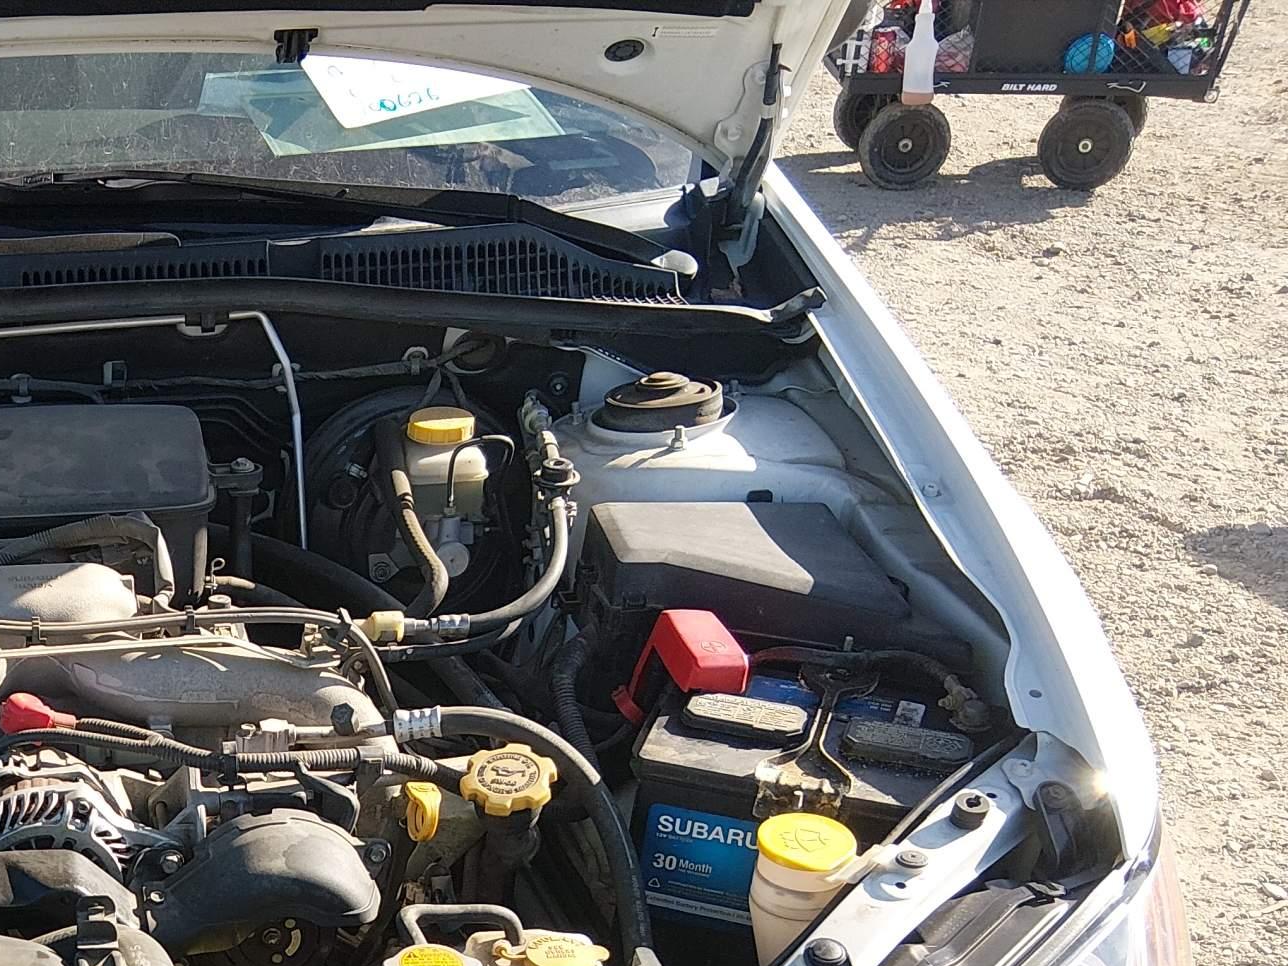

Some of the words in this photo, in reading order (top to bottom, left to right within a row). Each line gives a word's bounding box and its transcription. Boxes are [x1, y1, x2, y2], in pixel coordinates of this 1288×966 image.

[1001, 83, 1026, 91] BILT
[1027, 83, 1058, 92] HARD
[657, 815, 759, 850] SUBARU
[652, 852, 677, 871] 30
[678, 859, 713, 874] Month
